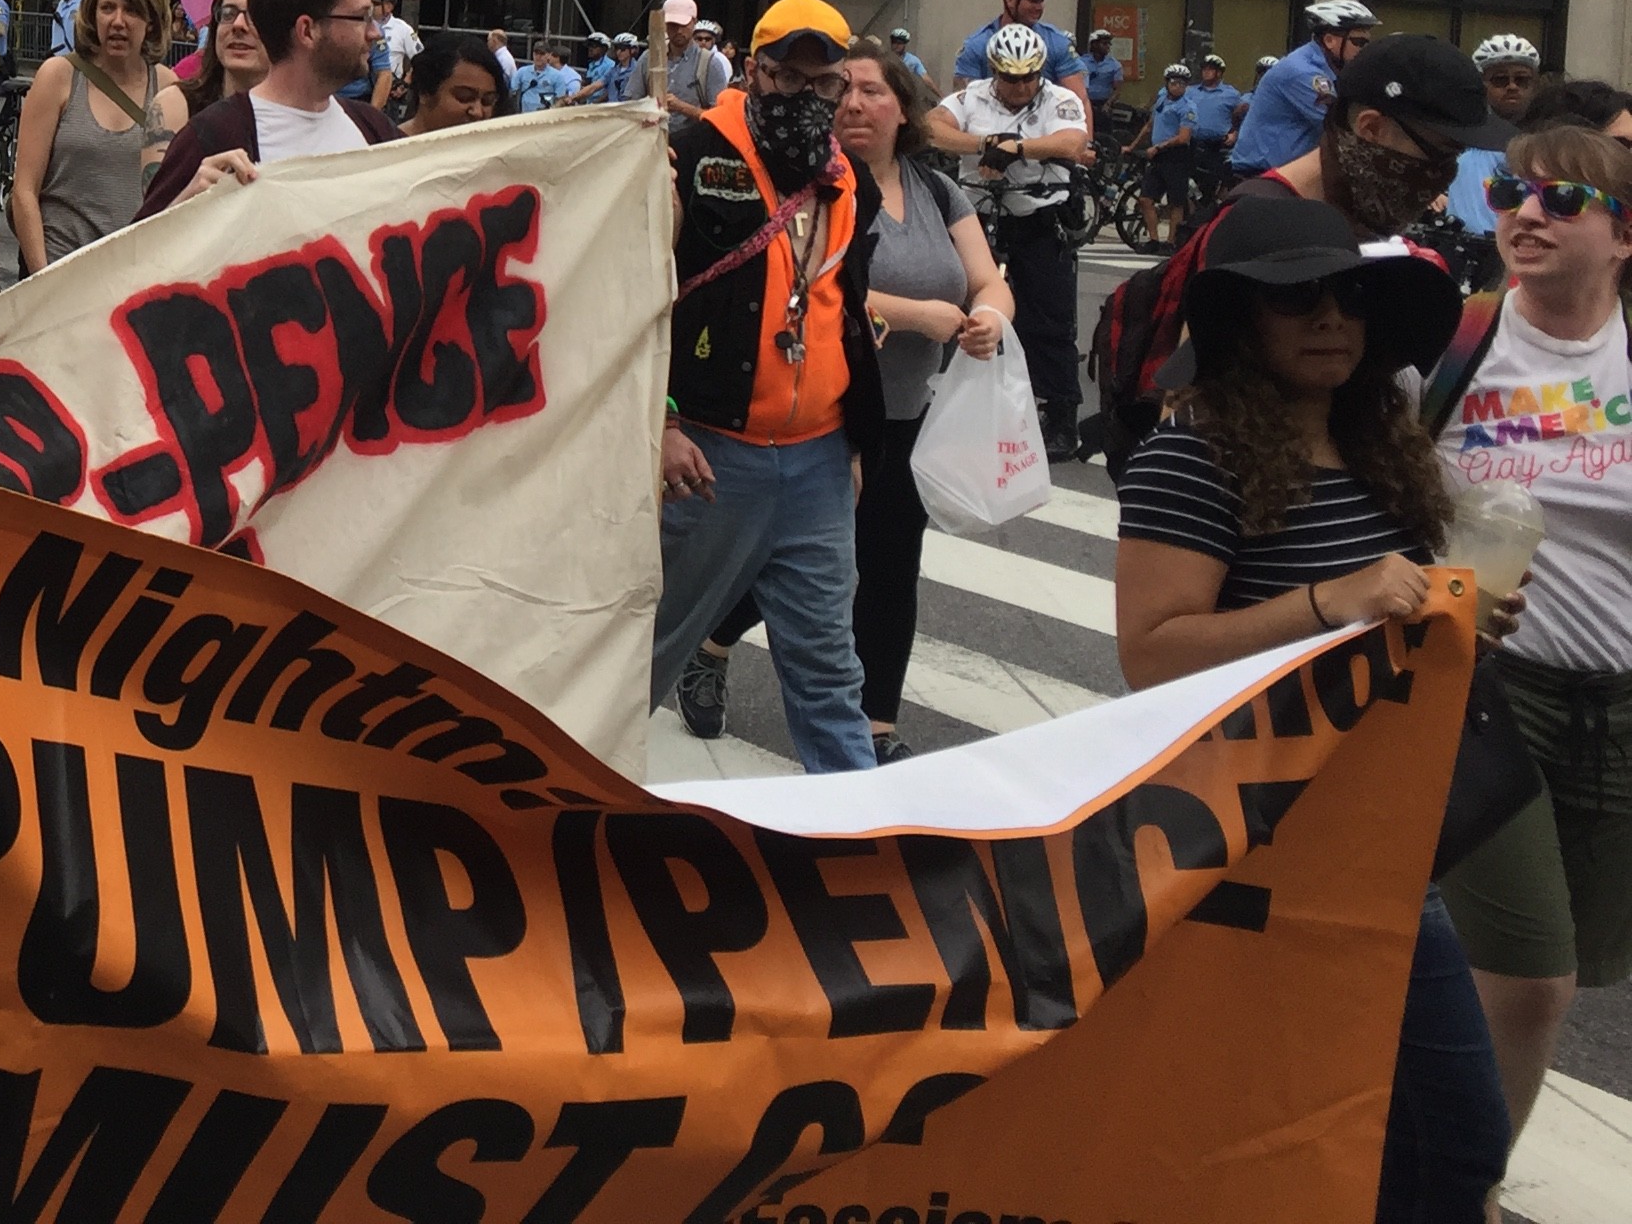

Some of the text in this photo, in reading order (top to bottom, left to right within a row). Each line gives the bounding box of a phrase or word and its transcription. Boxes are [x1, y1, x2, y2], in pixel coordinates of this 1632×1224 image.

[1103, 14, 1130, 30] MSC
[1459, 394, 1632, 453] AMERIC
[1462, 376, 1595, 425] MAKE
[1458, 436, 1632, 489] Gay Aga
